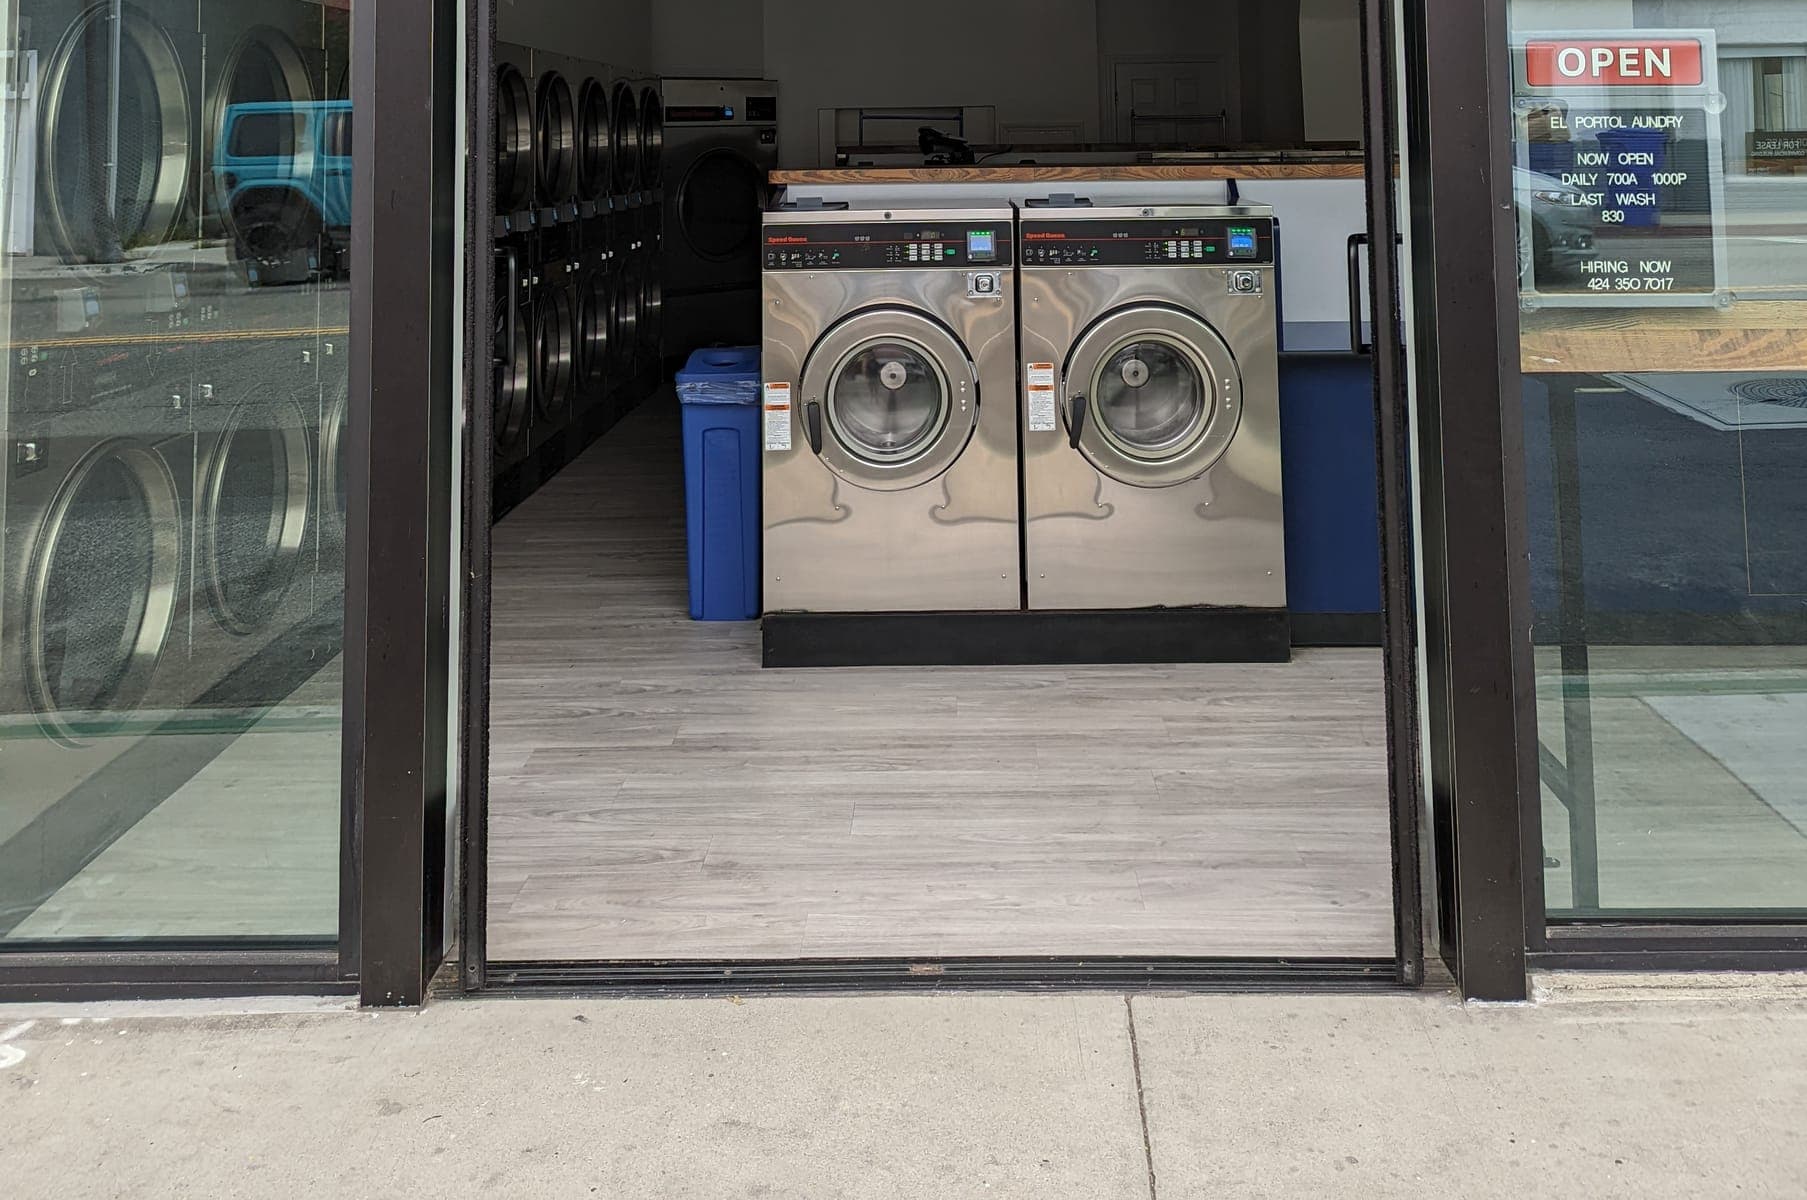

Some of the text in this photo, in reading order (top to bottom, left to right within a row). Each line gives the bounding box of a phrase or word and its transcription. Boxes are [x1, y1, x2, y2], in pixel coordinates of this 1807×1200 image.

[1557, 47, 1672, 78] OPEN
[1550, 115, 1684, 129] EL PORTOL AUNDRY
[1577, 153, 1654, 165] NOW OPEN
[1561, 173, 1687, 185] DAILY 700A 1000P
[1571, 193, 1655, 206] LAST WASH
[1602, 210, 1624, 222] 830
[1580, 260, 1671, 273] HIRING NOW
[1587, 278, 1674, 290] 424 350 7017
